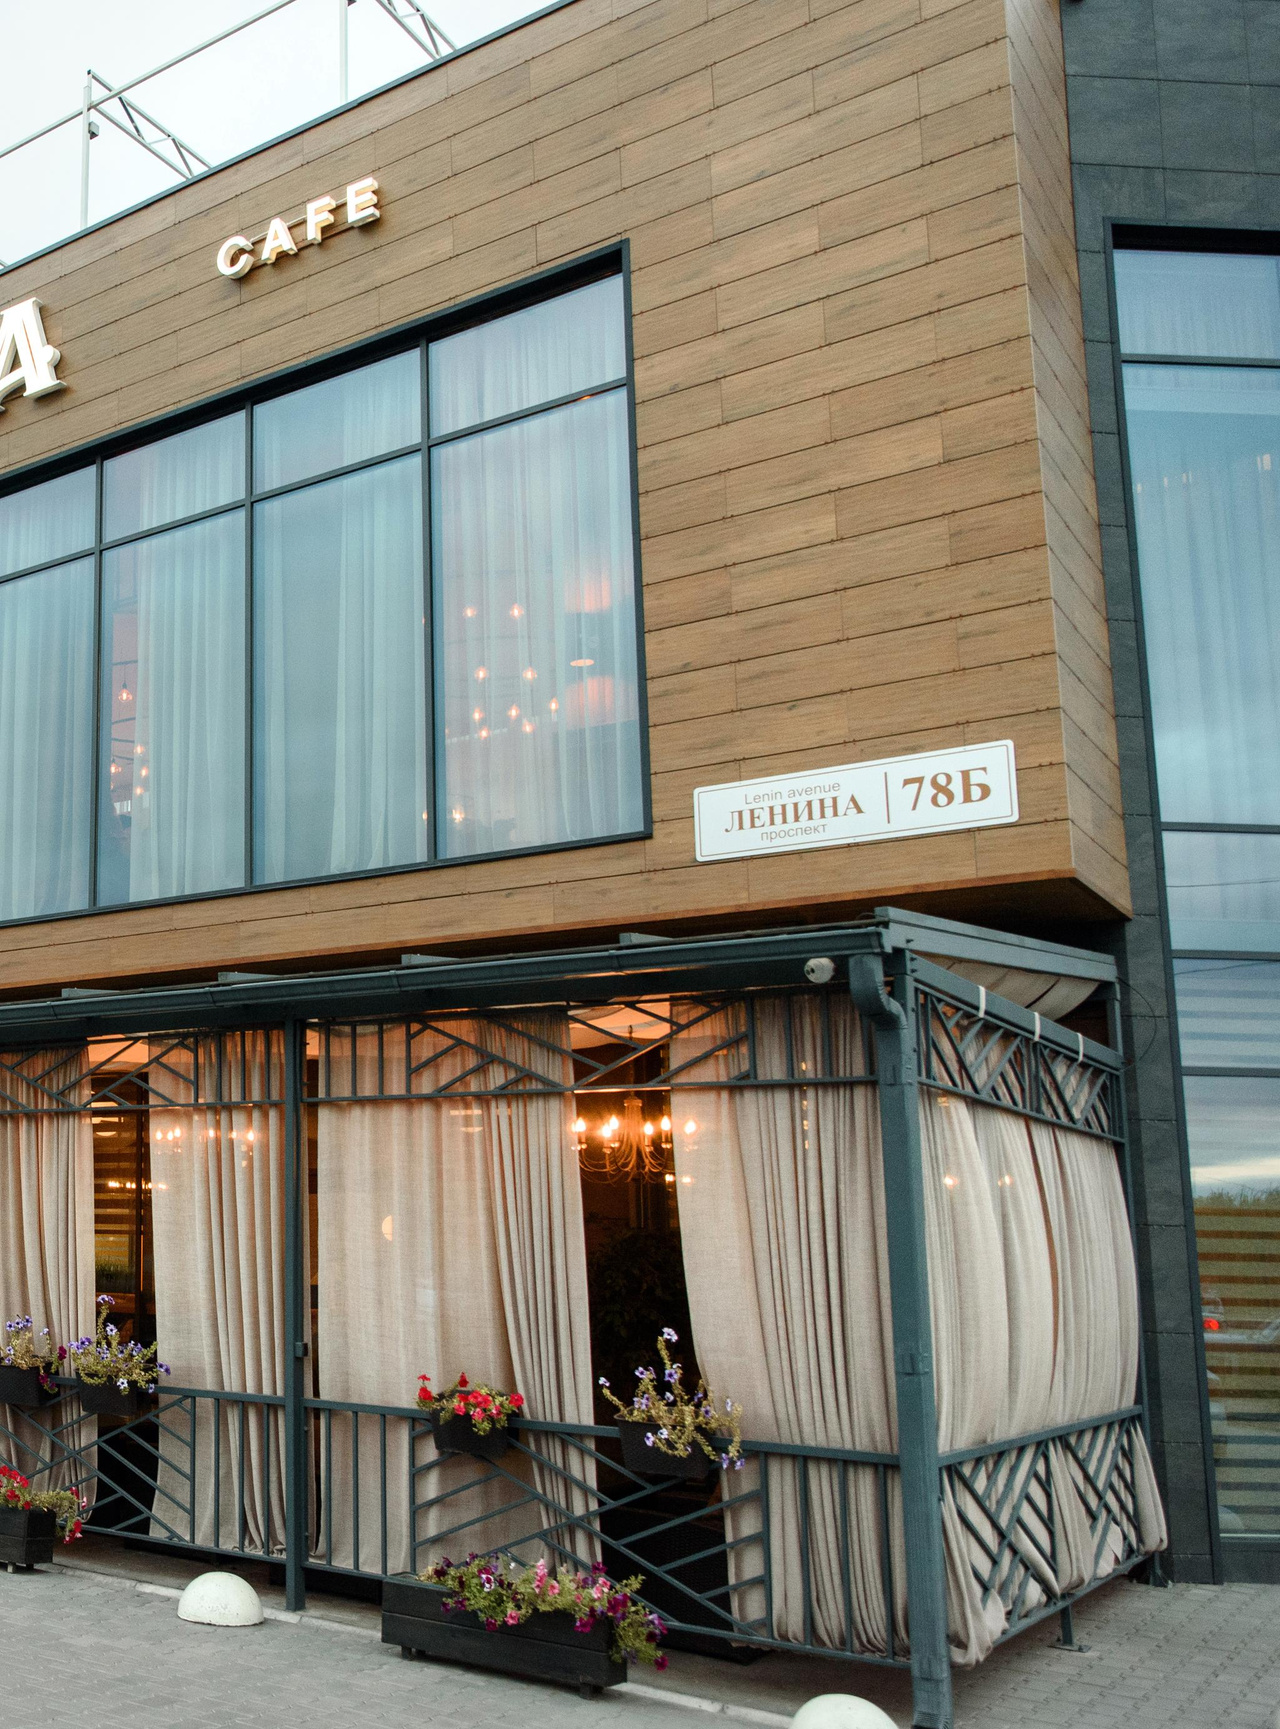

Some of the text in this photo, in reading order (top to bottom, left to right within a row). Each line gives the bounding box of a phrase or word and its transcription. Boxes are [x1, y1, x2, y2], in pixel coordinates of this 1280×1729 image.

[216, 177, 381, 280] CAFE
[744, 782, 841, 805] Lenin avenue
[901, 766, 992, 812] 78Б
[724, 794, 866, 833] ЛЕНИНА
[760, 823, 828, 842] проспект
